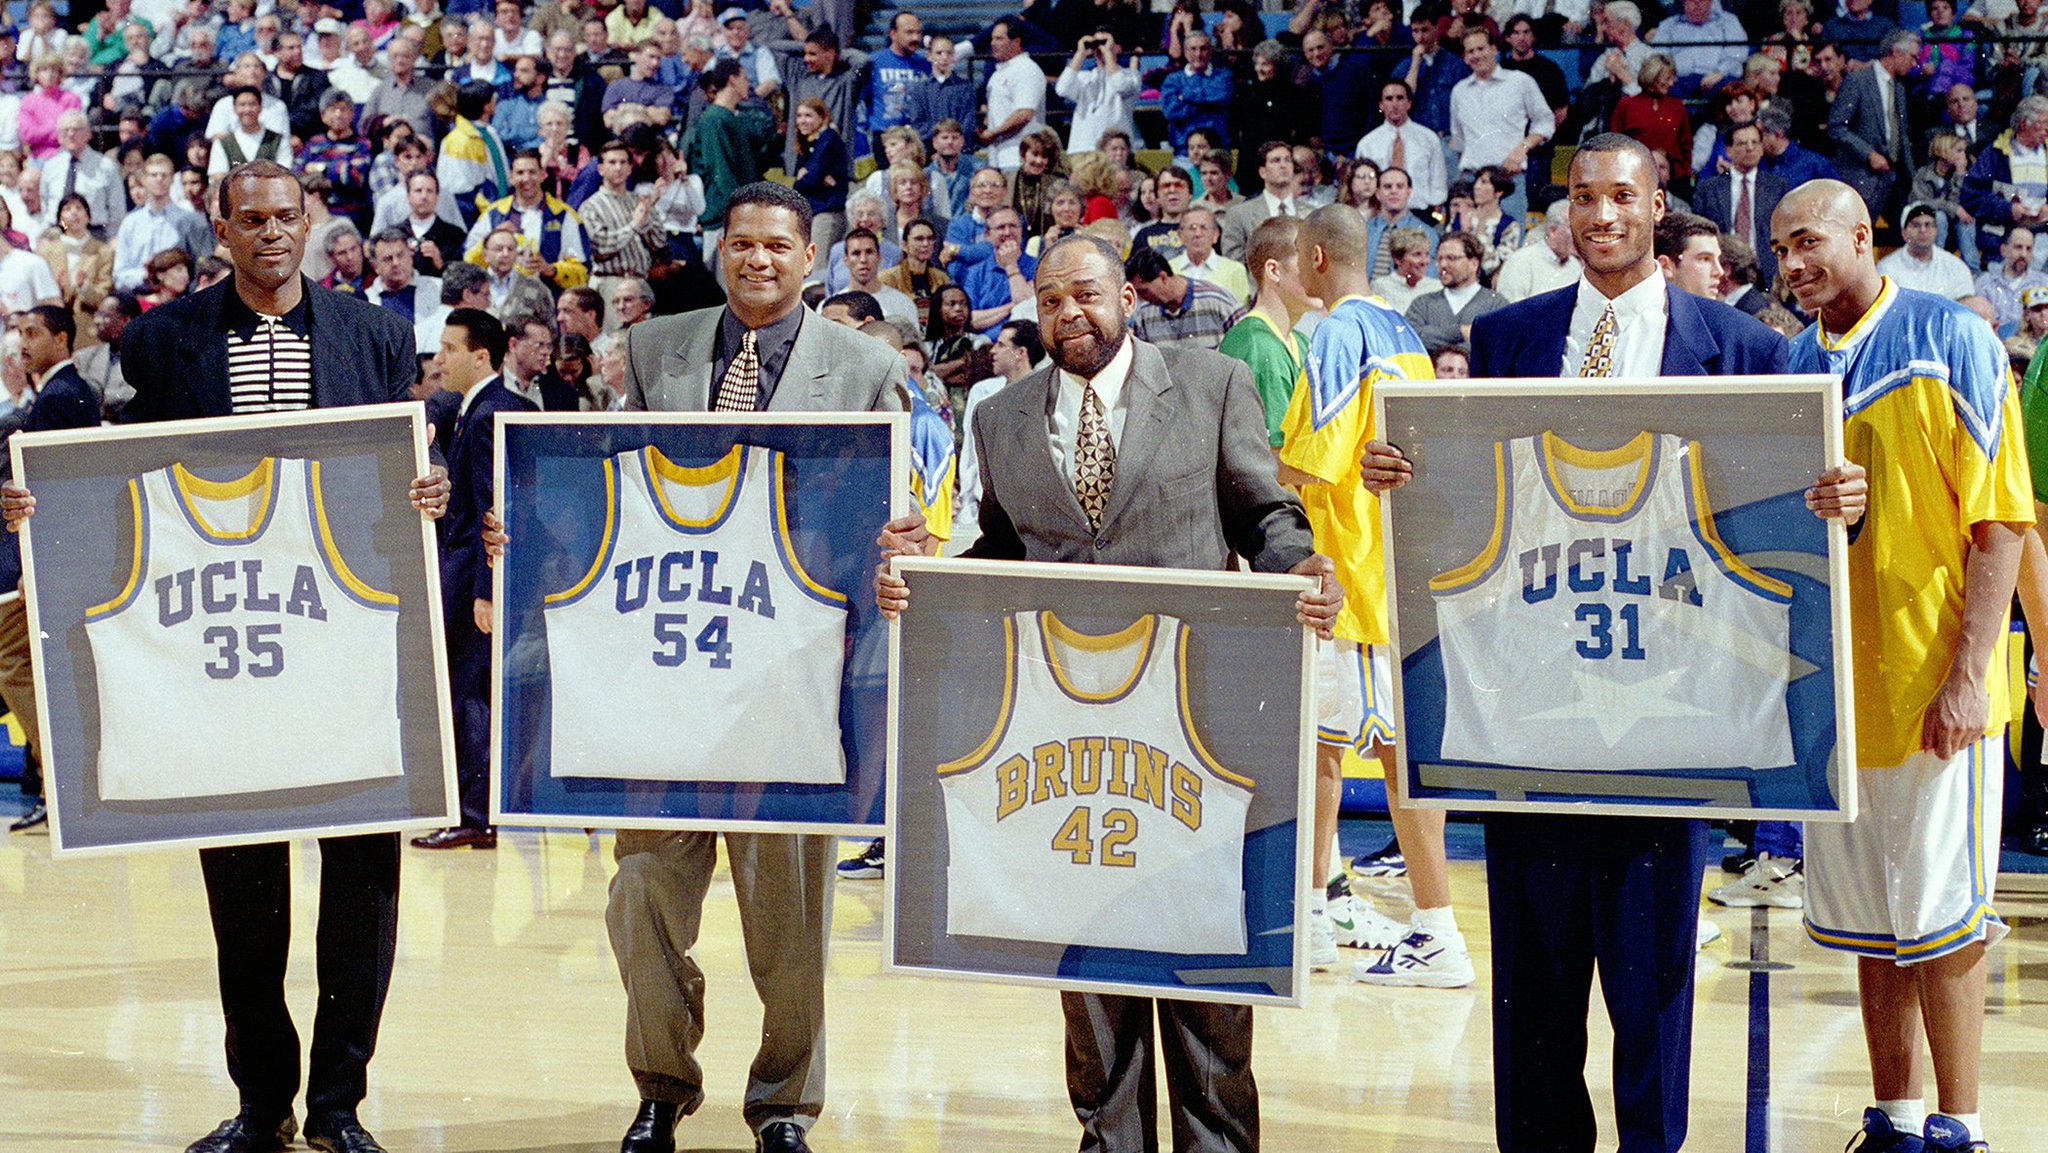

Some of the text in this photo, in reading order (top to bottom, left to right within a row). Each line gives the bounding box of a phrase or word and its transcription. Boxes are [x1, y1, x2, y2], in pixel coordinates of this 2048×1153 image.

[154, 559, 328, 628] UCLA
[613, 550, 776, 620] UCLA
[1518, 537, 1704, 605] UCLA
[203, 623, 285, 680] 35
[652, 613, 732, 669] 54
[1574, 602, 1646, 661] 31
[995, 736, 1203, 833] BRUINS
[1051, 806, 1139, 868] 42
